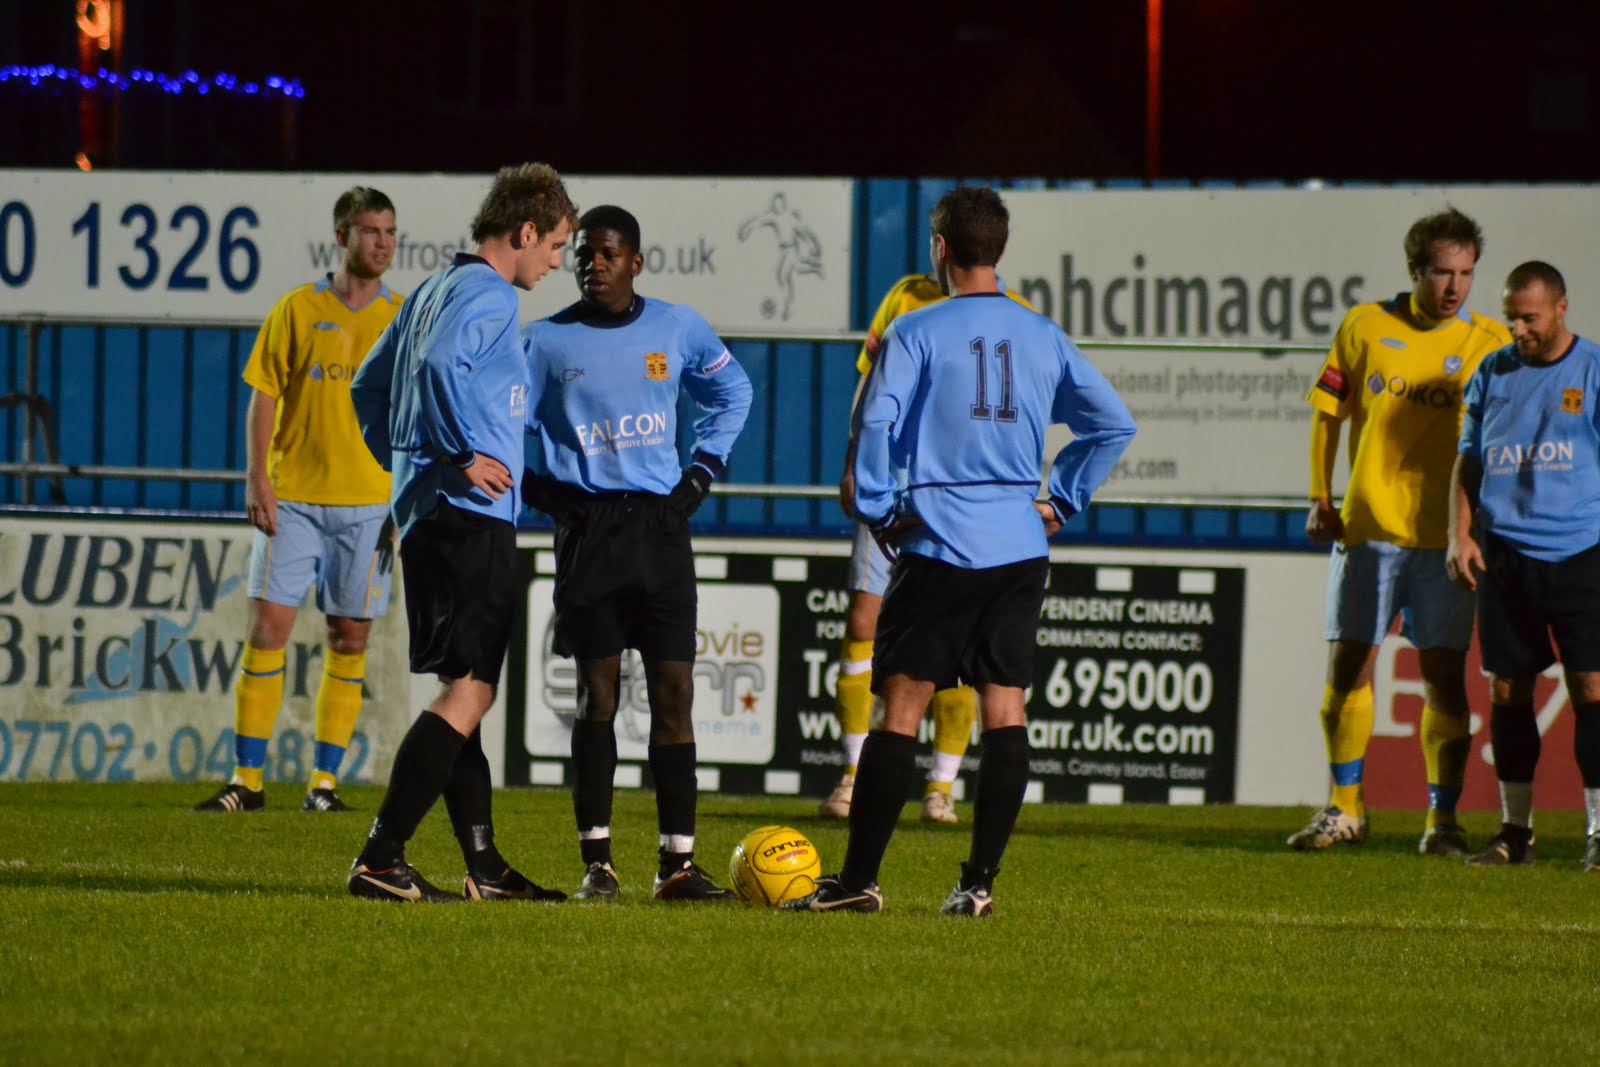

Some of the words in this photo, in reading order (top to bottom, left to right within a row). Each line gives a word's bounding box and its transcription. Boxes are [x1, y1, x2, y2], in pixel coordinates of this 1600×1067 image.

[72, 202, 260, 292] 1326
[969, 335, 1019, 423] 11
[575, 411, 667, 448] FALCON
[1128, 598, 1215, 625] CINEMA
[1035, 627, 1121, 649] ORMATION
[1045, 656, 1214, 713] 695000
